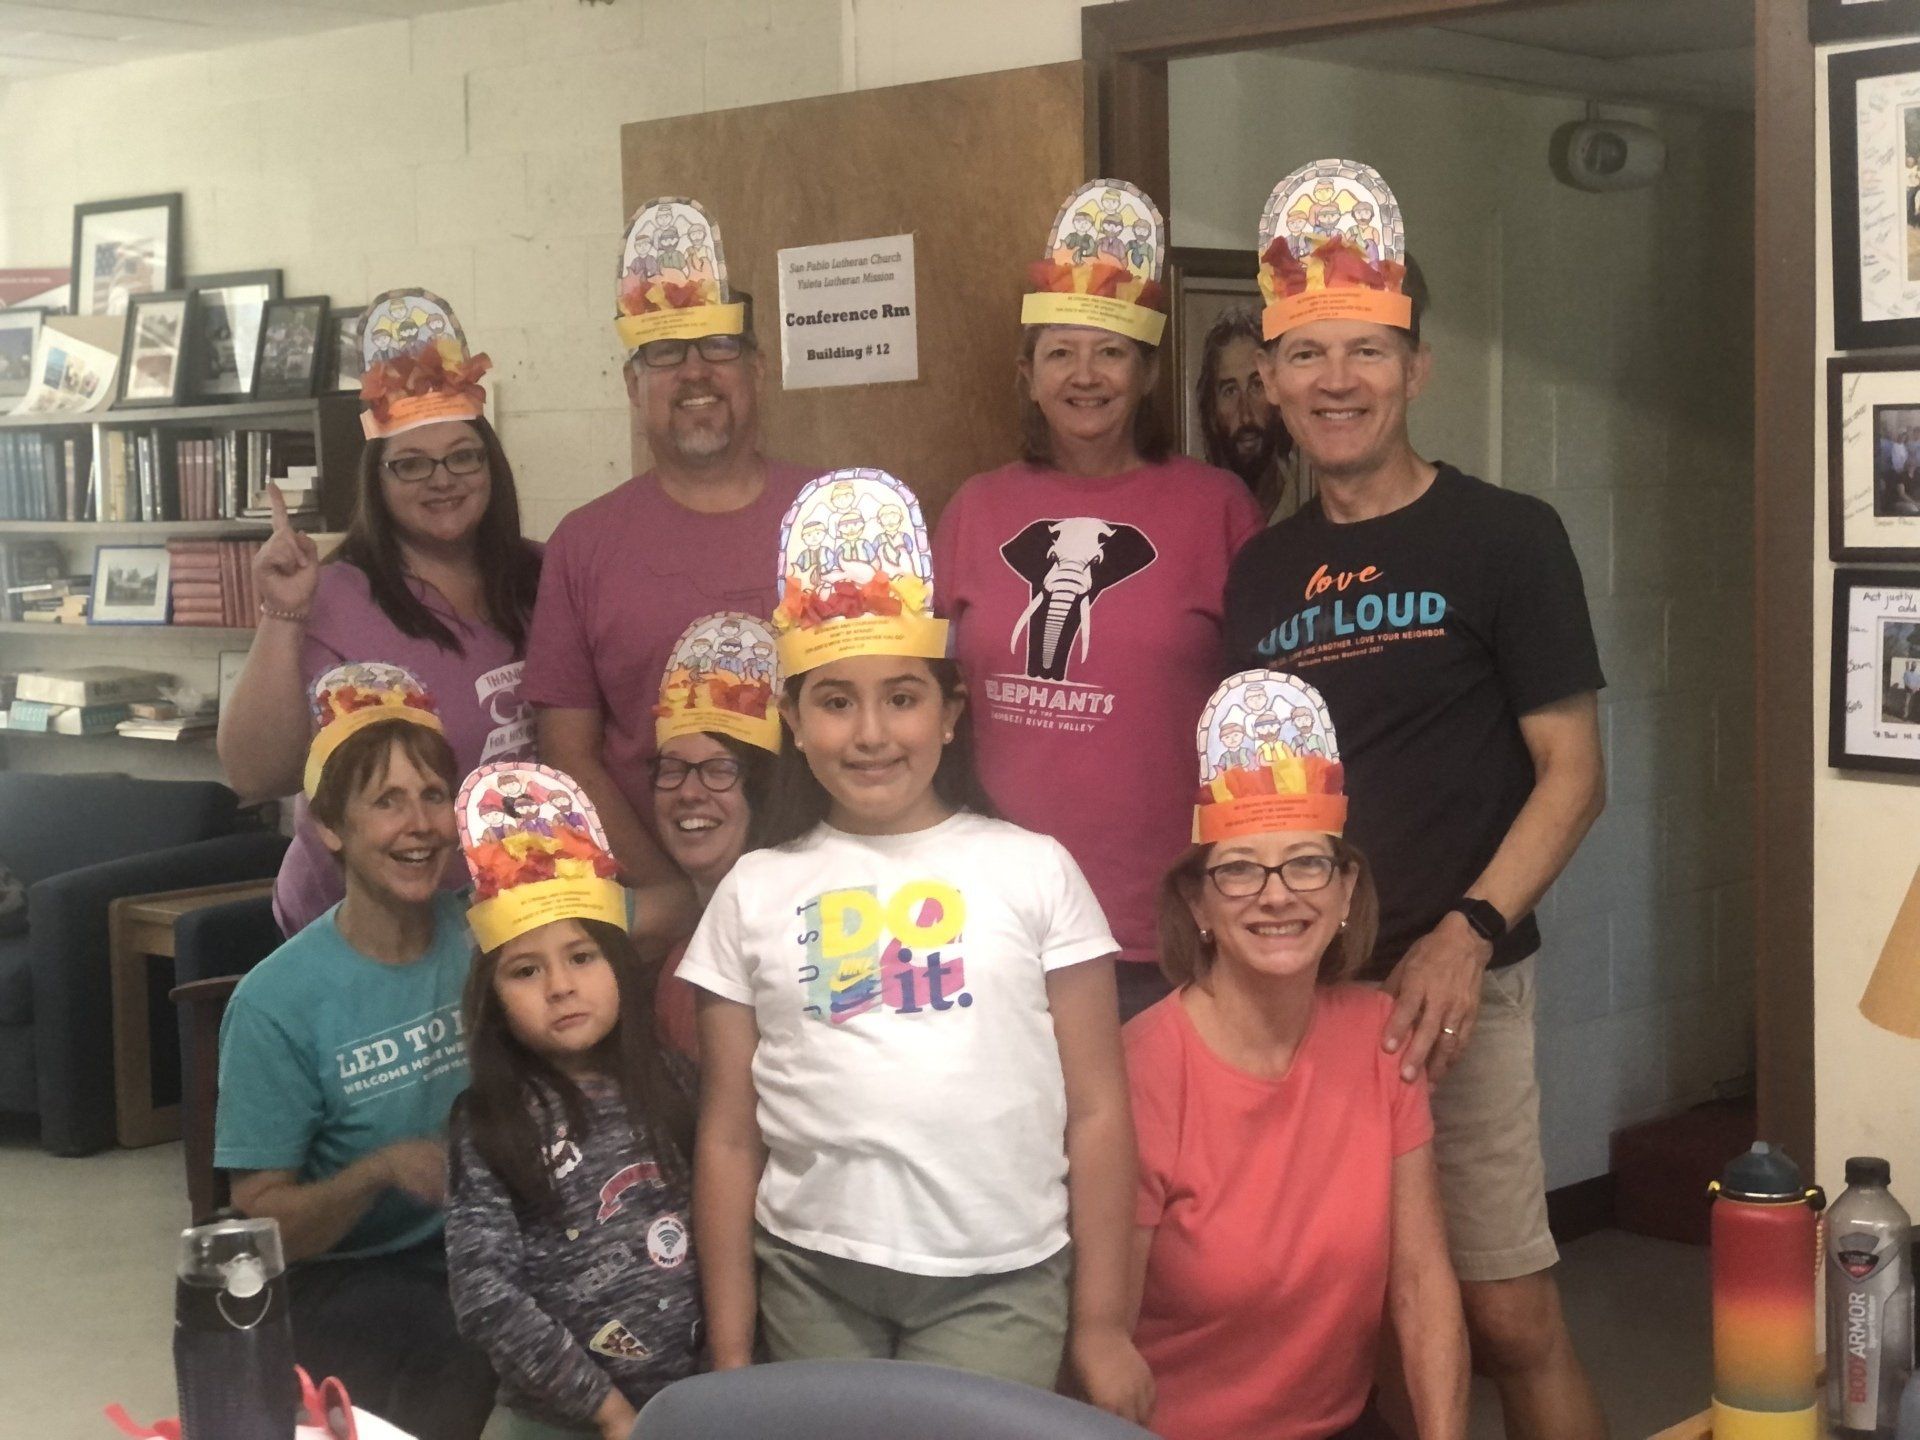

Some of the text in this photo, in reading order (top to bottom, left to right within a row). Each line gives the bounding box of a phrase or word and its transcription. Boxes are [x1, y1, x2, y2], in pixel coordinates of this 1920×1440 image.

[806, 260, 830, 273] Pablo
[832, 256, 869, 269] Lutheran
[870, 252, 902, 265] Church
[824, 275, 861, 288] Lutheran
[862, 271, 895, 284] Mission
[786, 303, 911, 327] Conference Rm
[807, 346, 863, 361] Building
[876, 343, 891, 355] 12
[1304, 563, 1385, 601] love
[1334, 591, 1447, 636] LOUD
[1863, 591, 1914, 610] Act justly
[1356, 634, 1375, 646] LOVE
[1377, 632, 1400, 643] YOUR
[984, 679, 1116, 715] ELEPHANTS
[1025, 718, 1055, 730] RIVER
[1057, 722, 1096, 734] VALLEY
[819, 878, 968, 960] DO
[796, 901, 822, 1015] JUST
[894, 947, 974, 1015] it.
[336, 1037, 399, 1079] LED
[403, 1018, 446, 1052] TO
[343, 1064, 410, 1095] WELCOME
[411, 1048, 443, 1071] HOE
